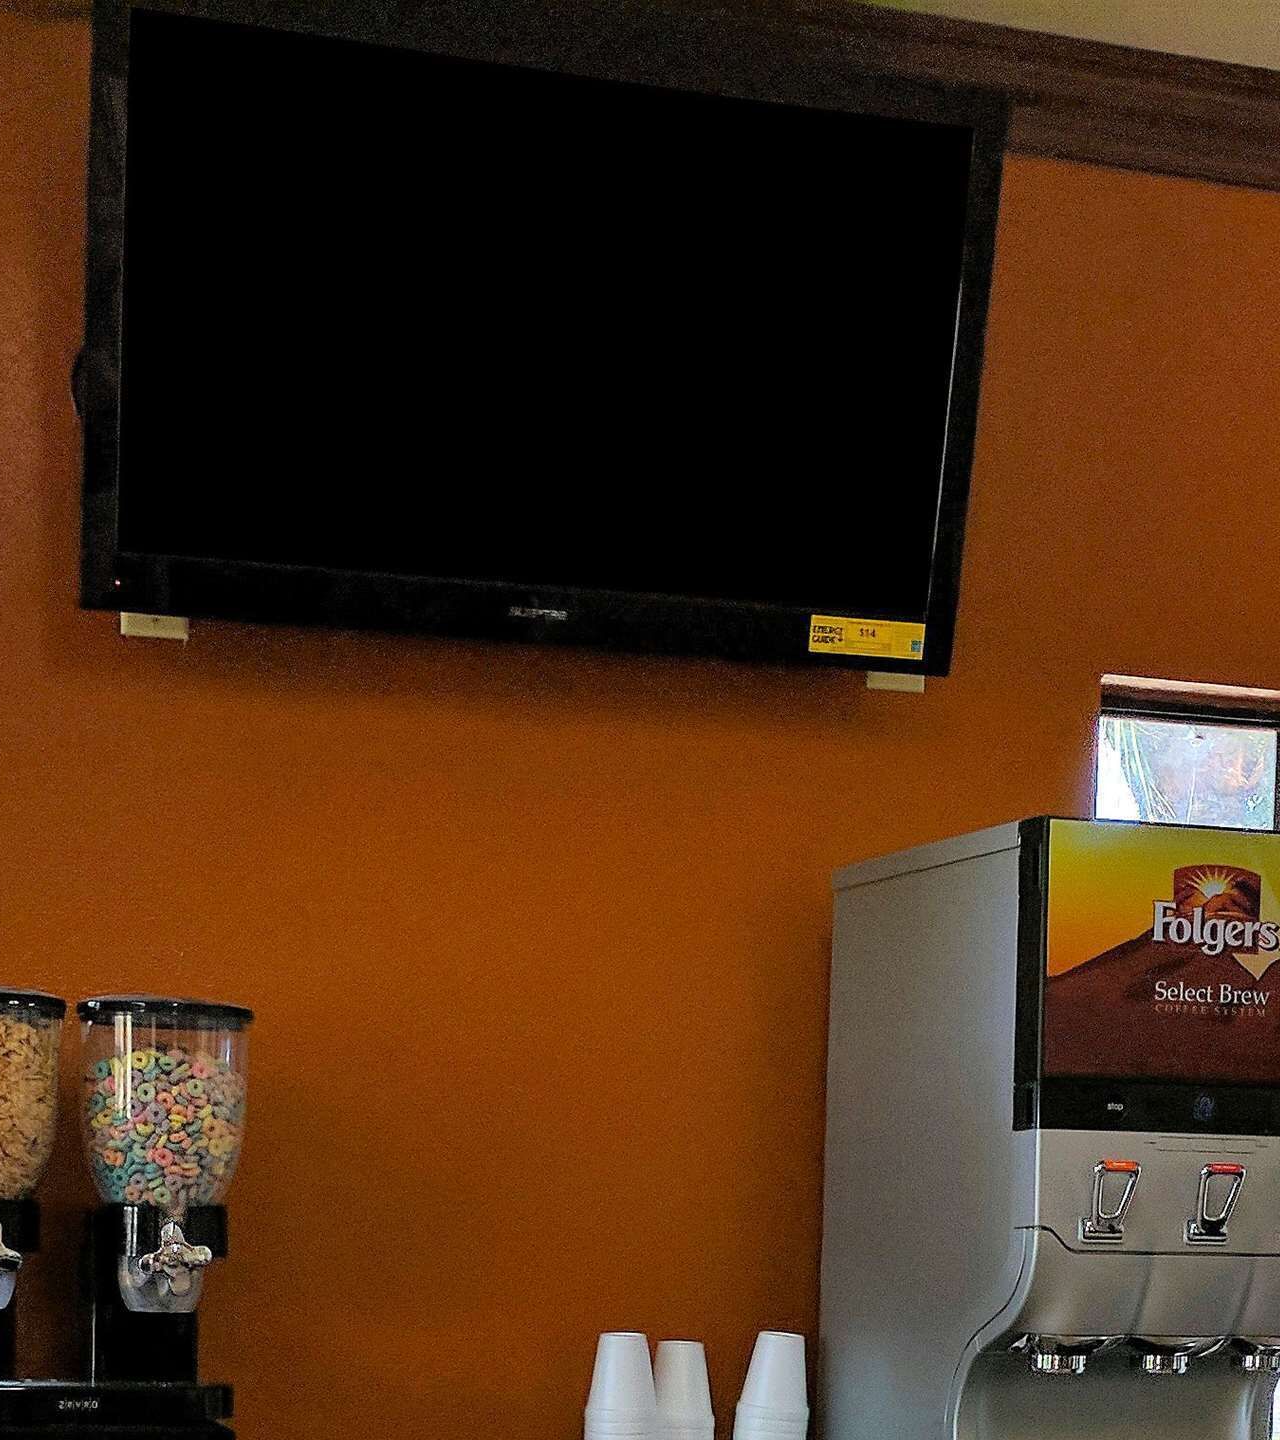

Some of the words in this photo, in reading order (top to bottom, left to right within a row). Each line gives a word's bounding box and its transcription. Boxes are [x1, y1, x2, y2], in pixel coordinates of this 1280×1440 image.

[1152, 900, 1280, 955] Folgers
[1154, 980, 1214, 1003] Select
[1219, 983, 1270, 1006] Brew
[1155, 1004, 1209, 1015] COFFEE
[1214, 1006, 1266, 1018] SYSTEM
[1107, 1102, 1124, 1112] stop
